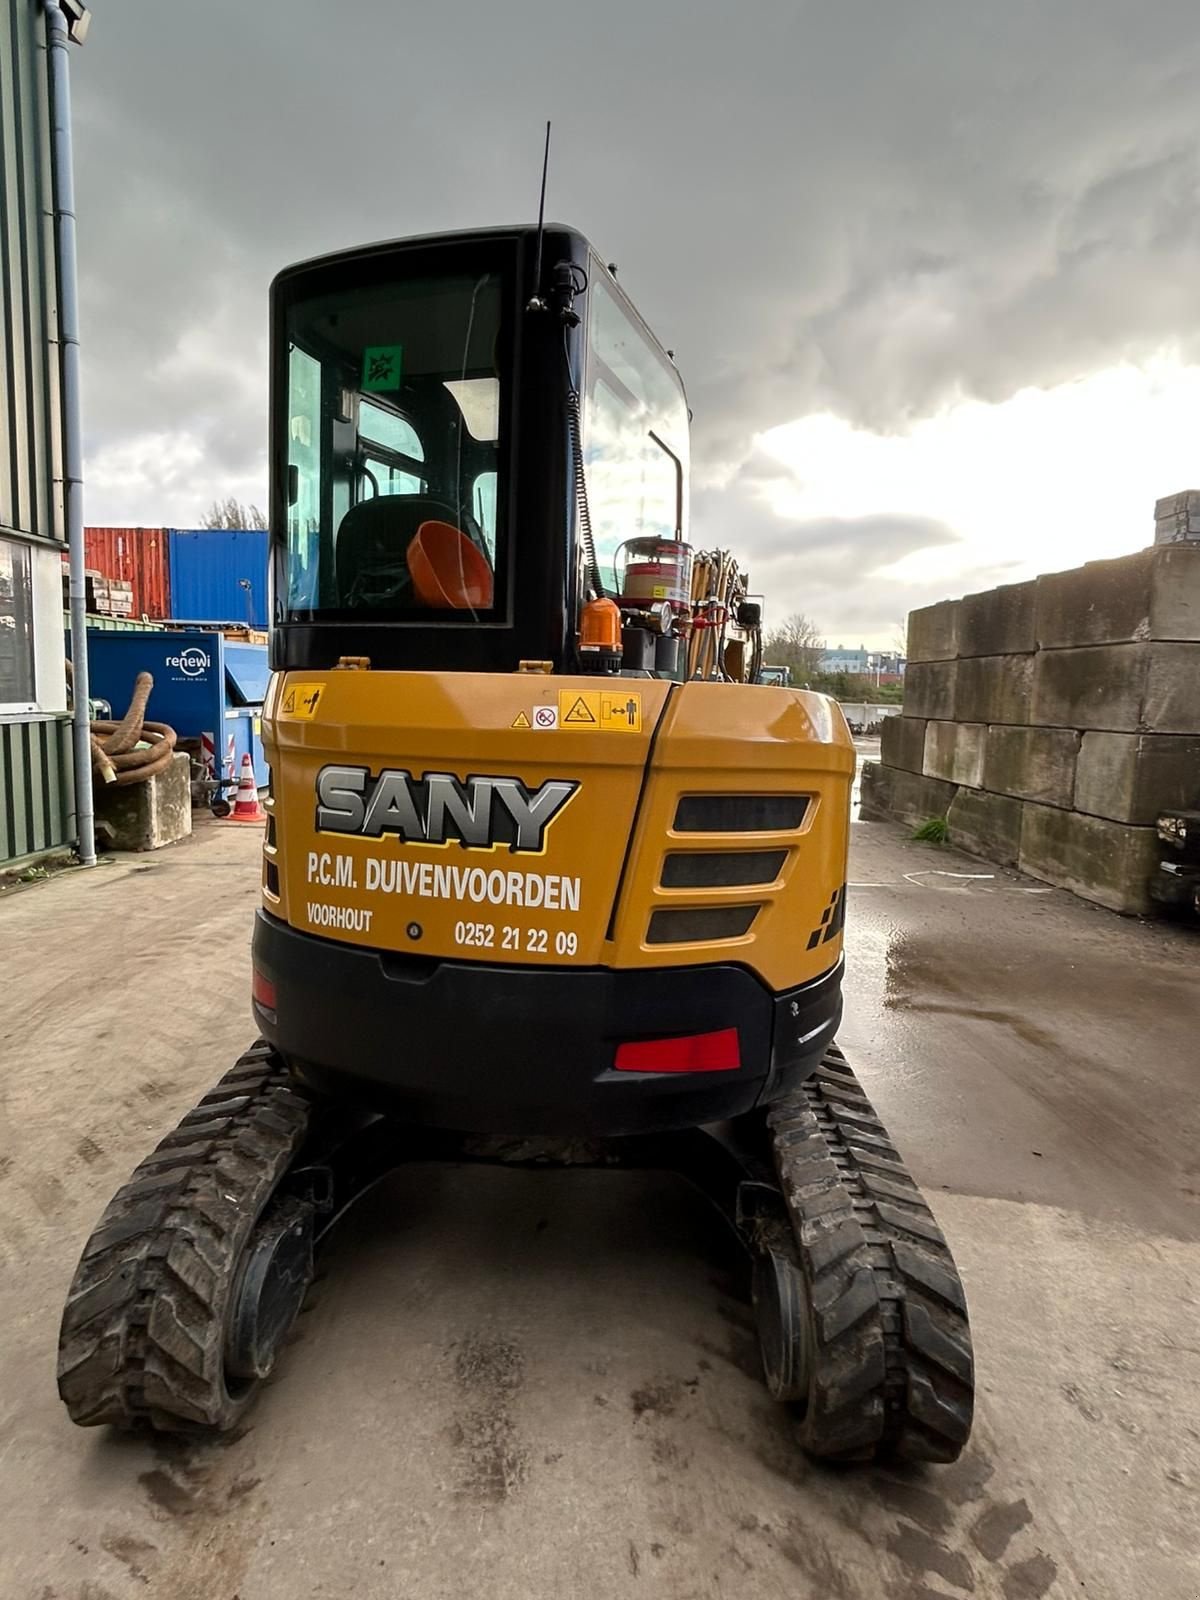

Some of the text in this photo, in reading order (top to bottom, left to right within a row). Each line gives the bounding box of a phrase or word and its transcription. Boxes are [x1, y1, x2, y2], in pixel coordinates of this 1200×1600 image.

[165, 653, 211, 668] renewi
[316, 764, 582, 855] SANY
[308, 852, 581, 911] P.C.M. DUIVENVOORDEN
[307, 902, 373, 932] VOORHOUT
[455, 921, 578, 955] 0252 21 22 09
